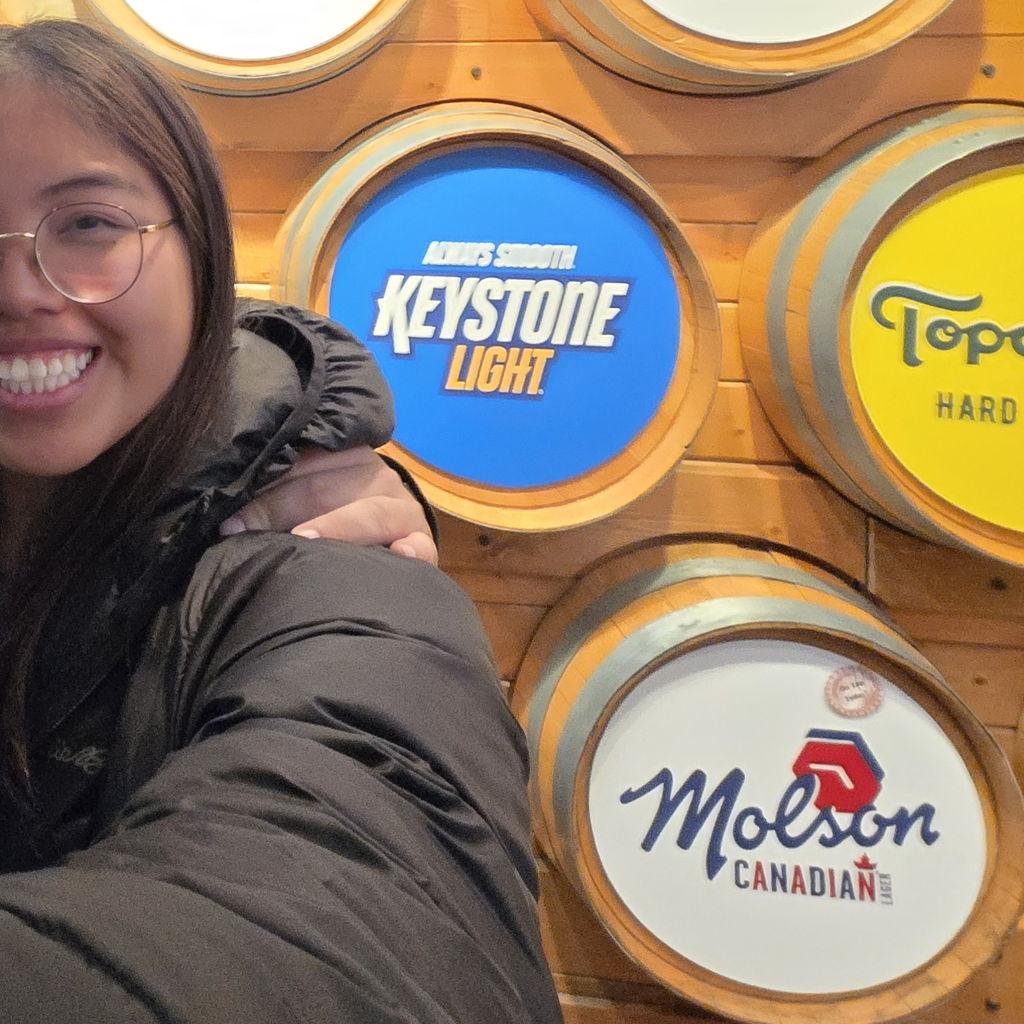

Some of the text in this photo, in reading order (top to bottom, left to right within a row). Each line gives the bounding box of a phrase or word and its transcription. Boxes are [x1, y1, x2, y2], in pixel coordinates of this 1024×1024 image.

[372, 273, 630, 355] KEYSTONE
[444, 344, 555, 396] LIGHT
[935, 391, 1018, 425] HARD
[619, 766, 941, 881] Molson
[733, 858, 877, 904] CANADIAN
[878, 872, 894, 907] LAGER
